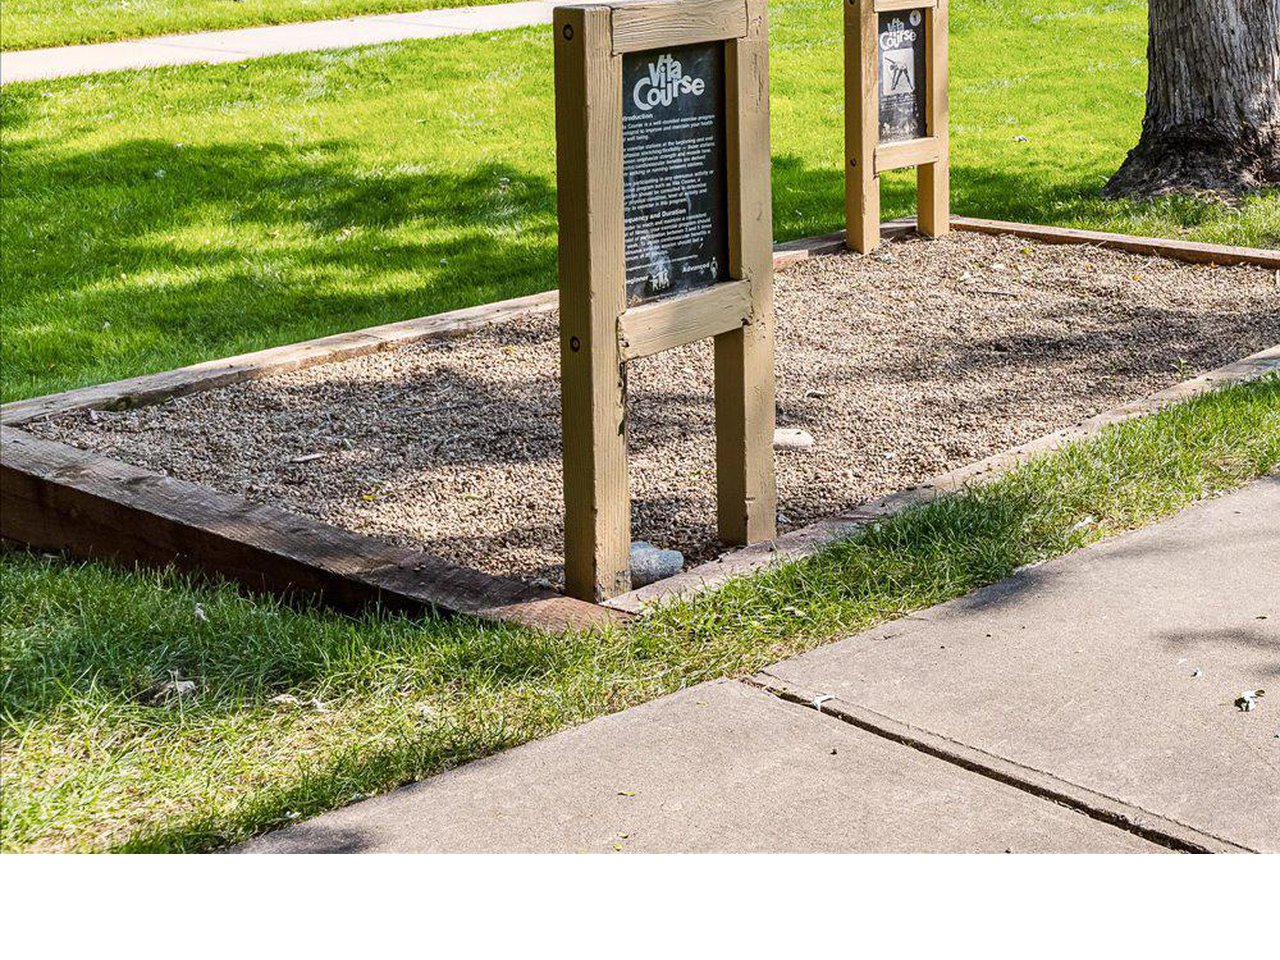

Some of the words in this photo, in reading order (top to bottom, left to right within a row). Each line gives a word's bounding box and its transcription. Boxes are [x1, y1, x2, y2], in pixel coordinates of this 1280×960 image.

[887, 18, 905, 33] Vita
[880, 29, 917, 50] Course
[648, 53, 682, 88] Vita
[633, 75, 705, 111] Course
[662, 208, 686, 216] Duration
[682, 262, 710, 273] Advanced
